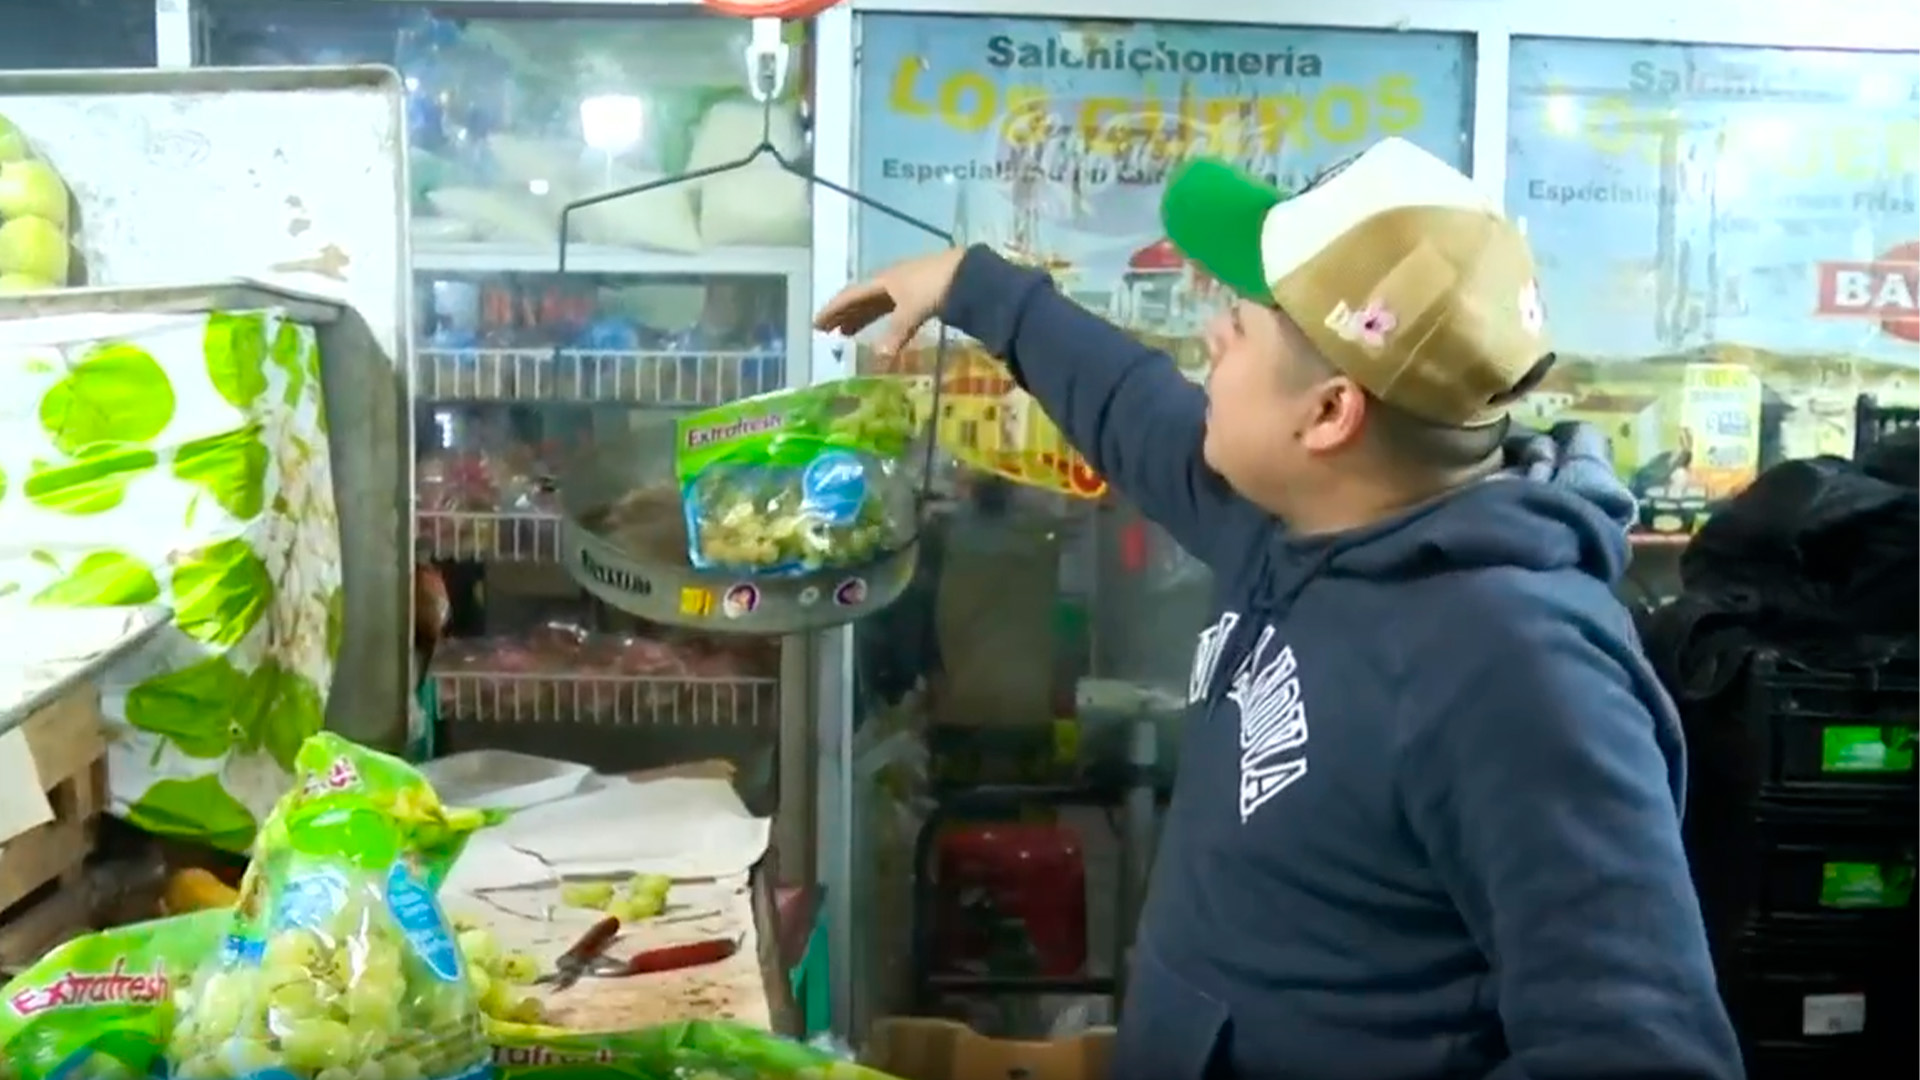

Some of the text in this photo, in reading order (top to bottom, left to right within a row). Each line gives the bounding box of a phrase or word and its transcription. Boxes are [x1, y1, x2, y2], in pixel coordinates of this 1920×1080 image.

[889, 54, 1050, 148] LOS
[1835, 270, 1920, 308] BA
[12, 956, 170, 1016] Extrafresh
